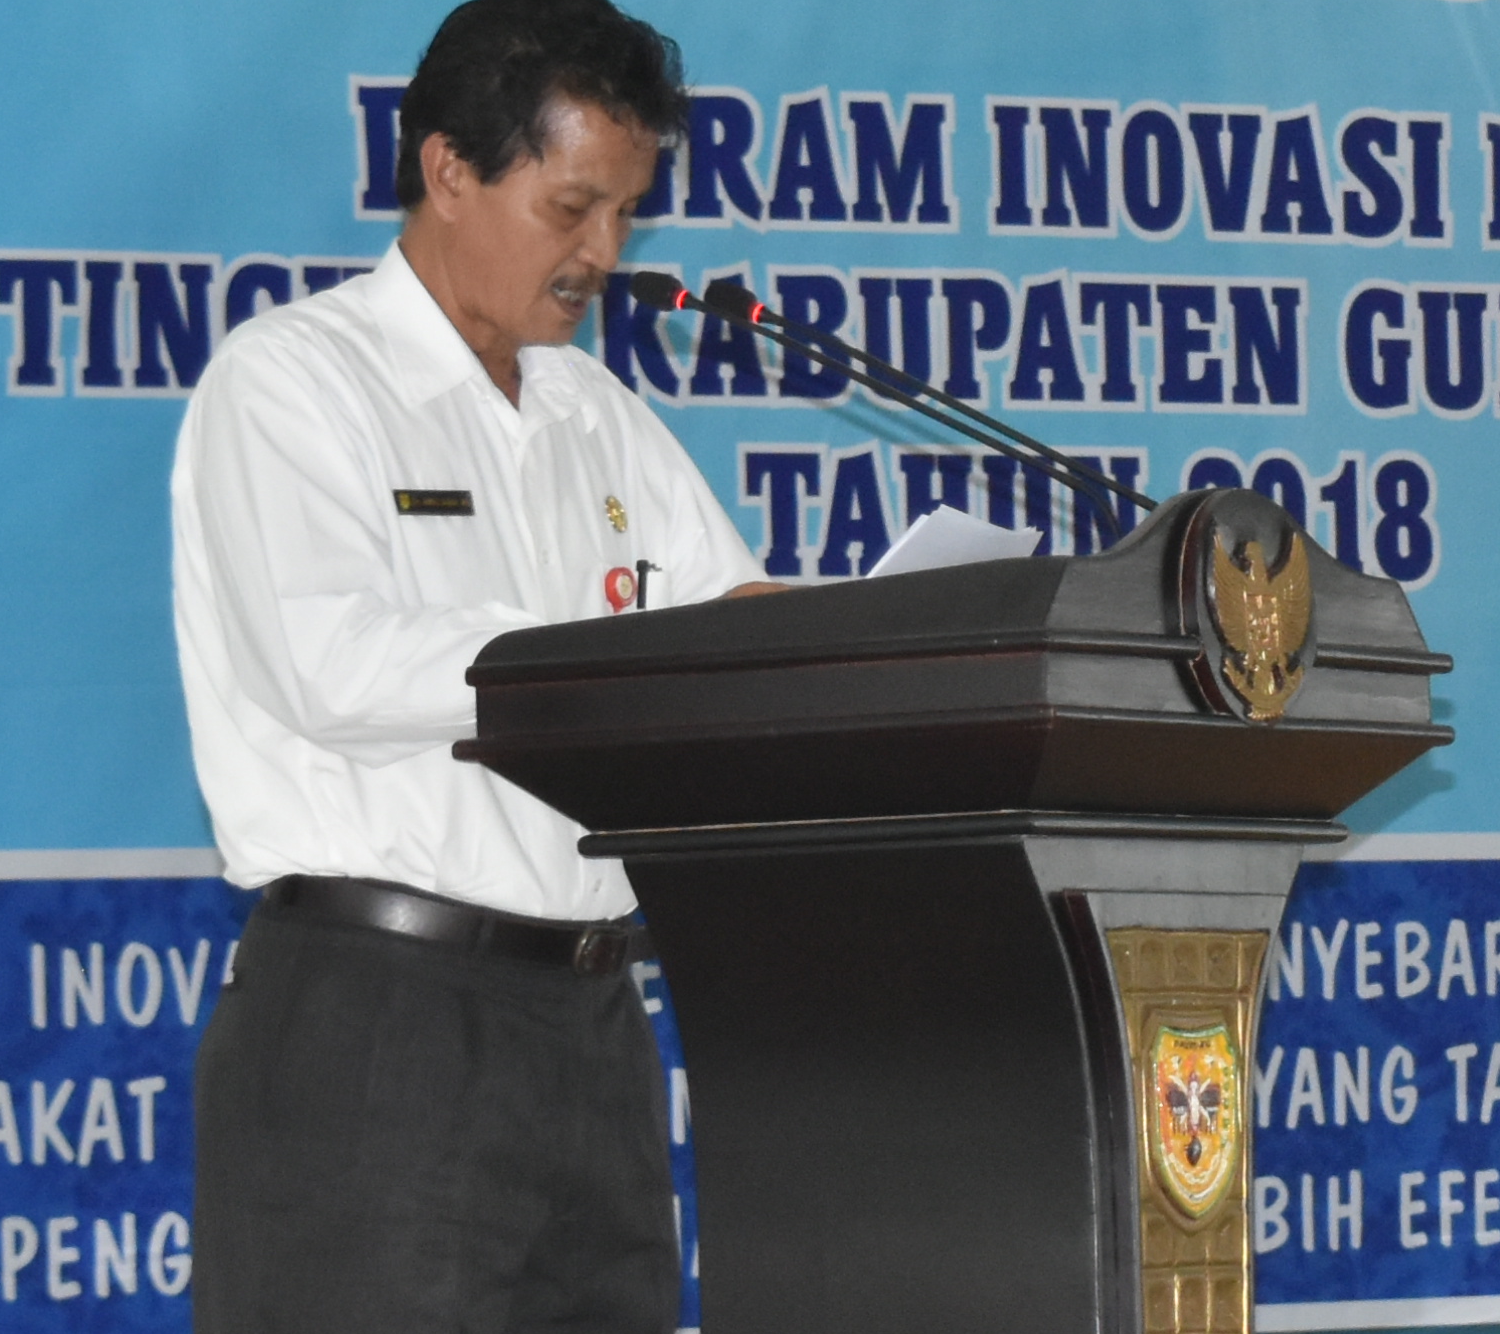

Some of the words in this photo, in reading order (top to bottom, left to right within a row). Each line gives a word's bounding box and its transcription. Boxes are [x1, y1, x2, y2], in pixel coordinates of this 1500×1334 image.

[986, 98, 1453, 248] INOVASI
[599, 263, 1309, 416] KABUPATEN
[30, 937, 240, 1030] INOV
[1253, 1044, 1419, 1130] YANG
